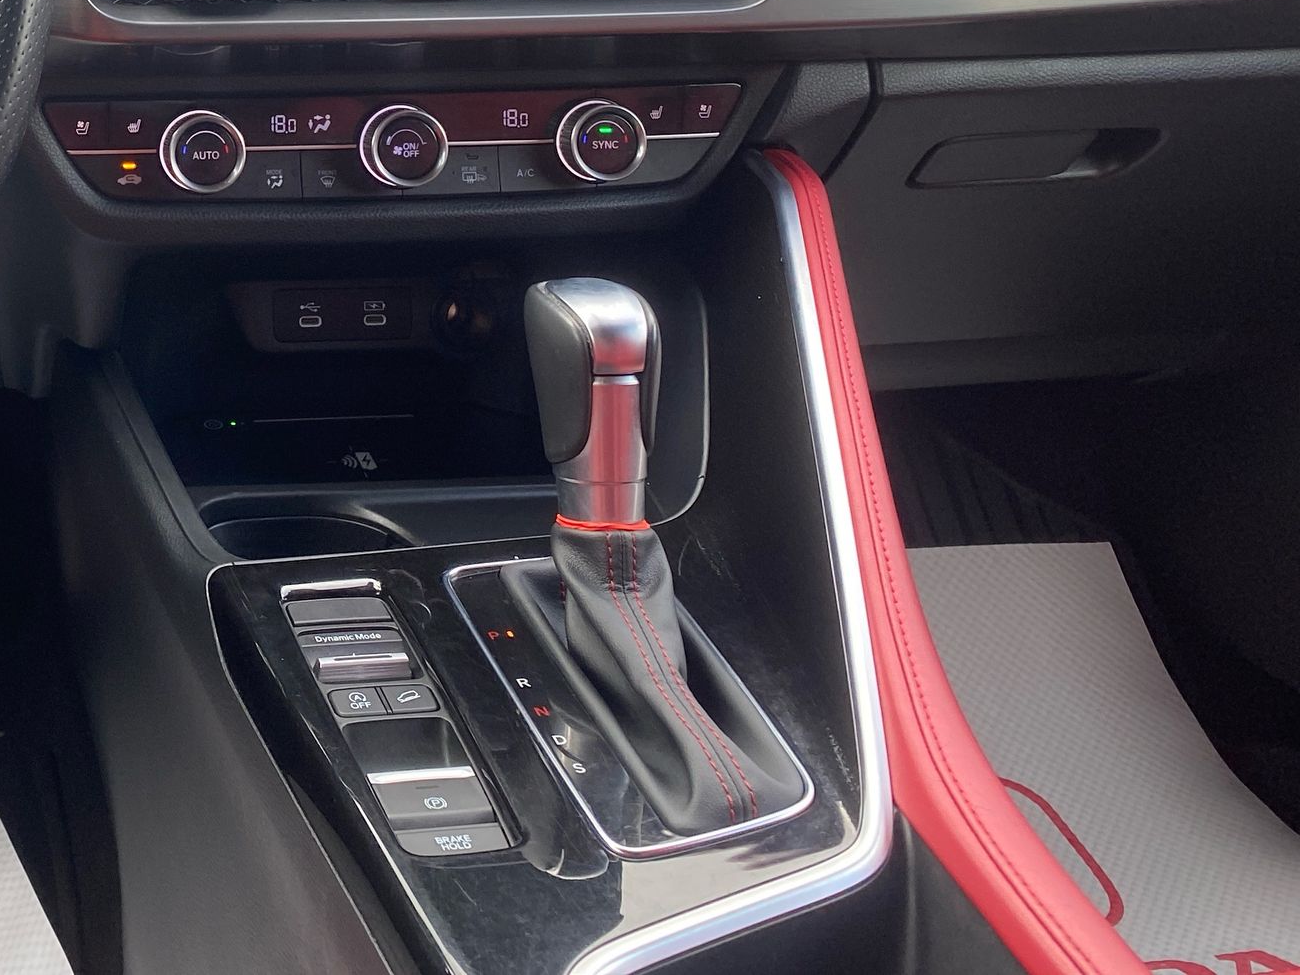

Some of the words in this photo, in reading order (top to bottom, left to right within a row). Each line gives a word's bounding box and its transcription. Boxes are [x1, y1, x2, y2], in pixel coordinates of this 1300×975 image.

[592, 139, 619, 150] SYNC
[192, 150, 220, 161] AUTO
[403, 150, 420, 158] OFF
[516, 167, 535, 178] A/C
[314, 633, 353, 644] Dynamic
[354, 631, 382, 642] Mode
[486, 630, 500, 641] P
[515, 677, 532, 689] R
[350, 701, 371, 709] OFF
[532, 706, 550, 717] N
[552, 734, 568, 746] D
[572, 763, 587, 775] S
[434, 833, 473, 845] BRAKE
[440, 840, 473, 852] HOLD
